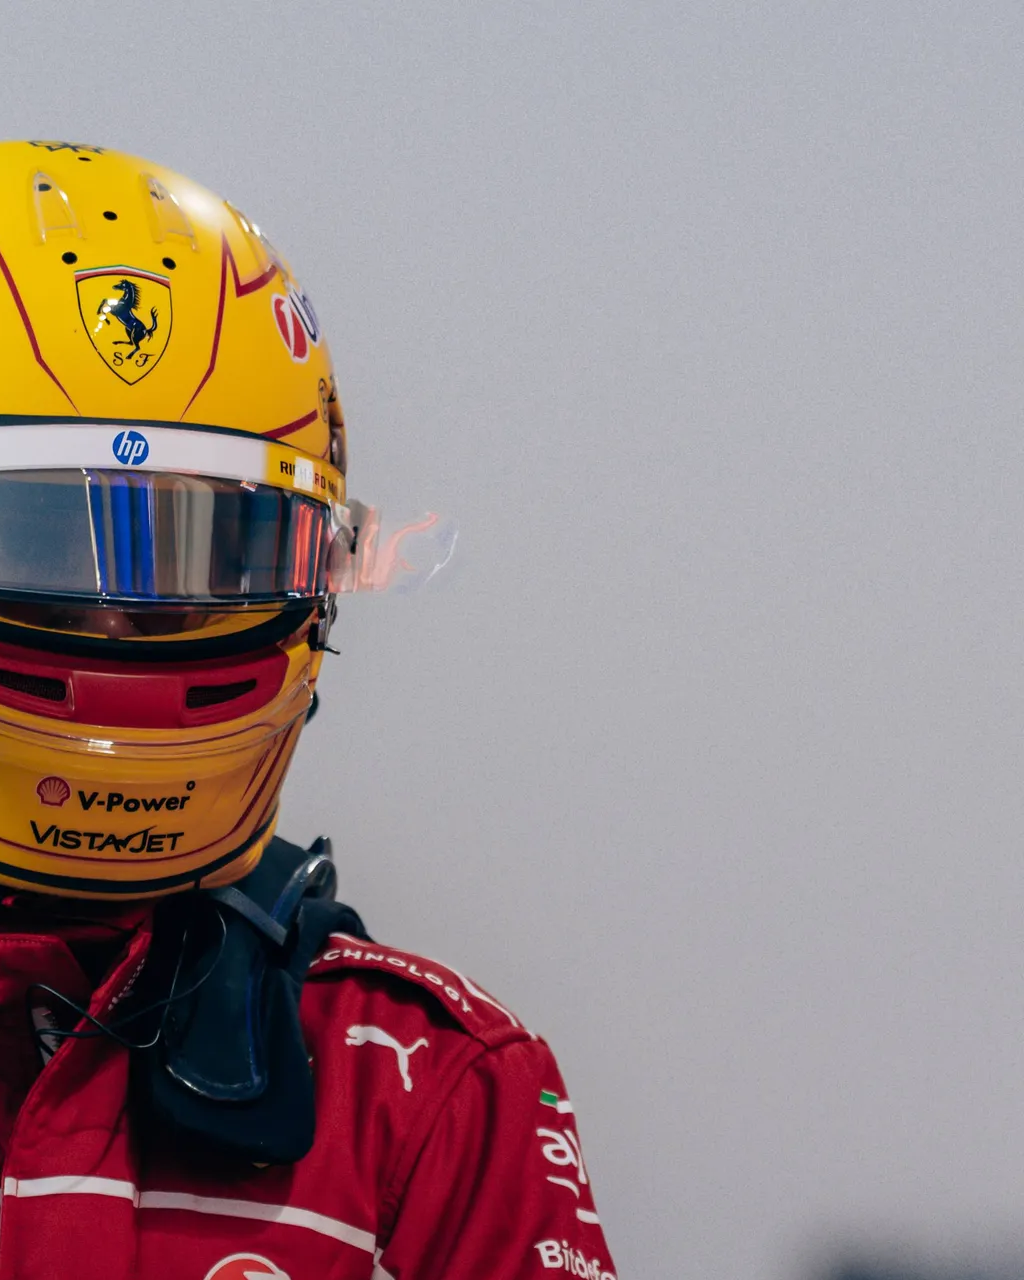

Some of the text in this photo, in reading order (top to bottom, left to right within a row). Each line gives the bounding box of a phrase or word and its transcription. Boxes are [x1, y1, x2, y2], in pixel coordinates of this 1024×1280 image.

[114, 430, 148, 466] hp
[78, 789, 191, 812] V-Power
[309, 948, 472, 1013] CHNOLOGY
